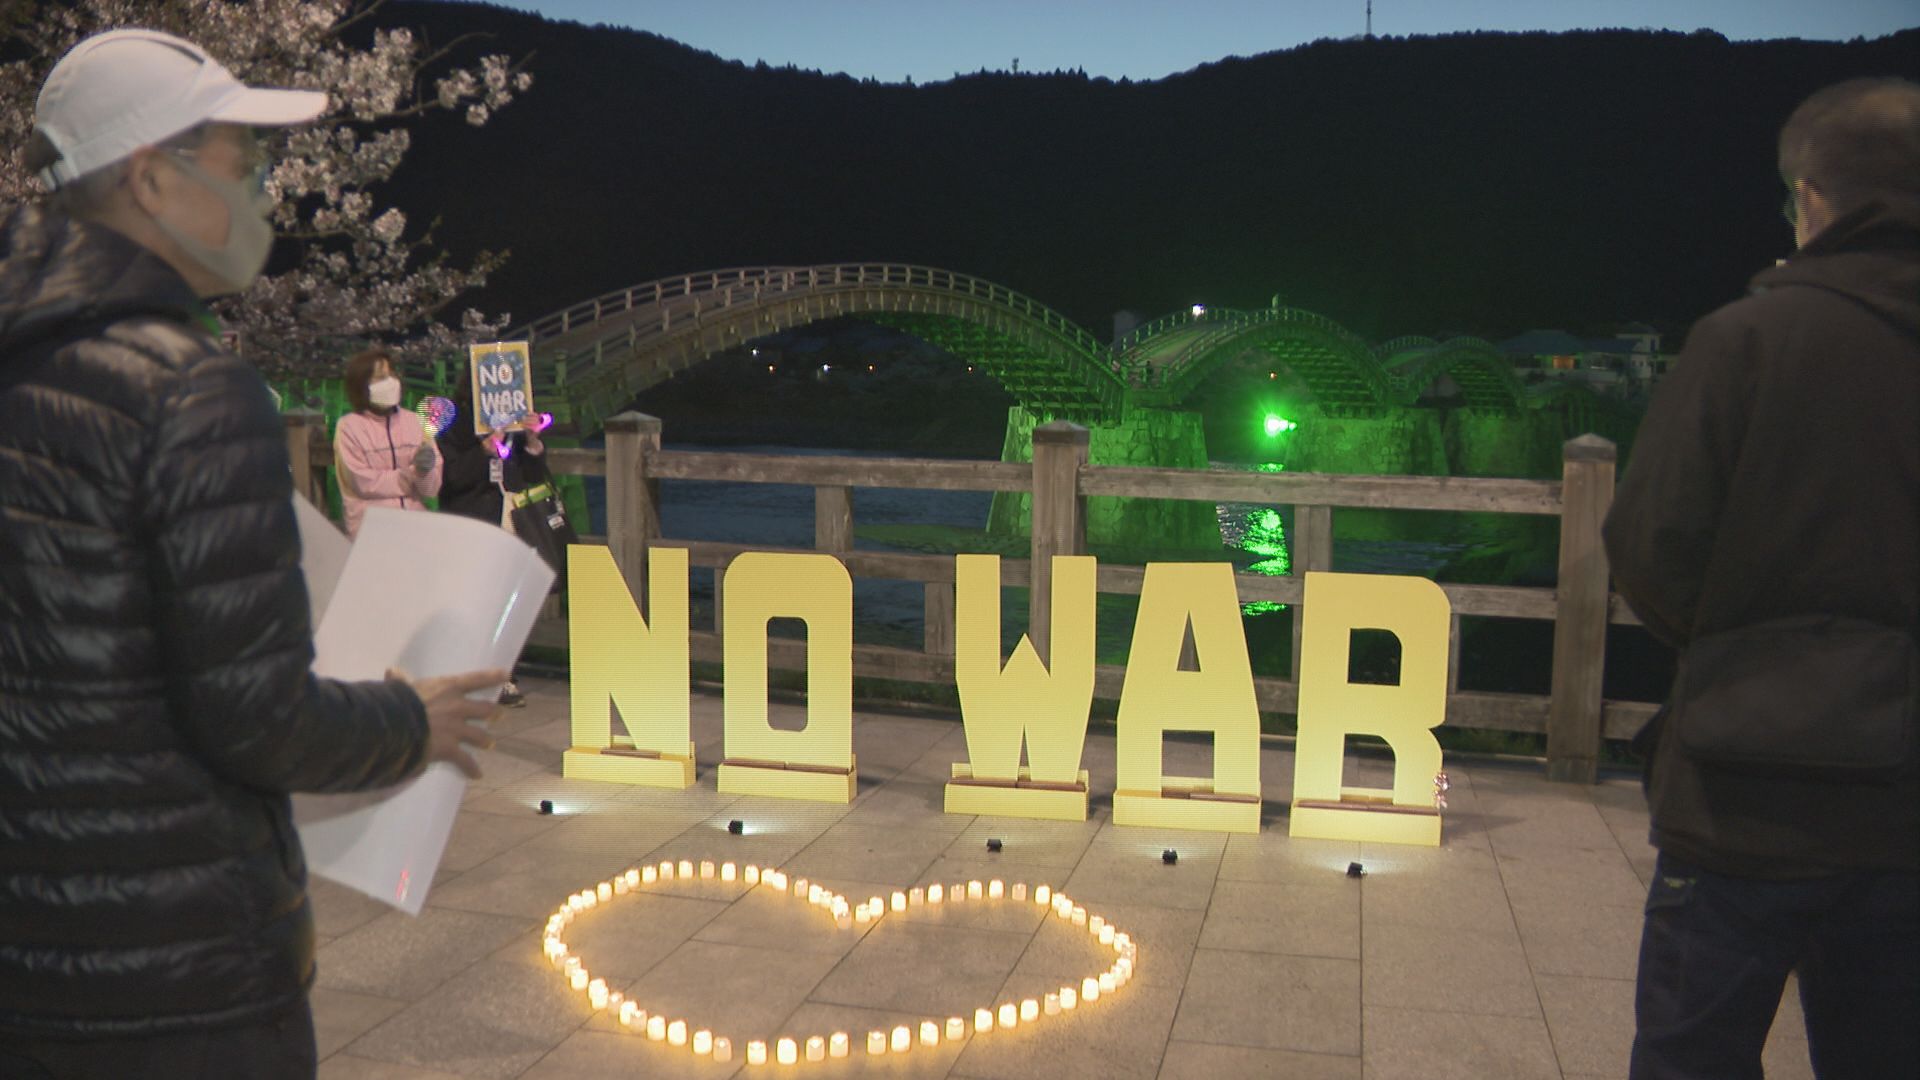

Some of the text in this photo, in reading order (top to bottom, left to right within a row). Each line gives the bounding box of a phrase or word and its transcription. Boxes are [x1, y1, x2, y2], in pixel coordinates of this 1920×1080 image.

[480, 363, 513, 387] NO
[481, 390, 527, 416] WAR
[567, 544, 1451, 806] NO WAR
